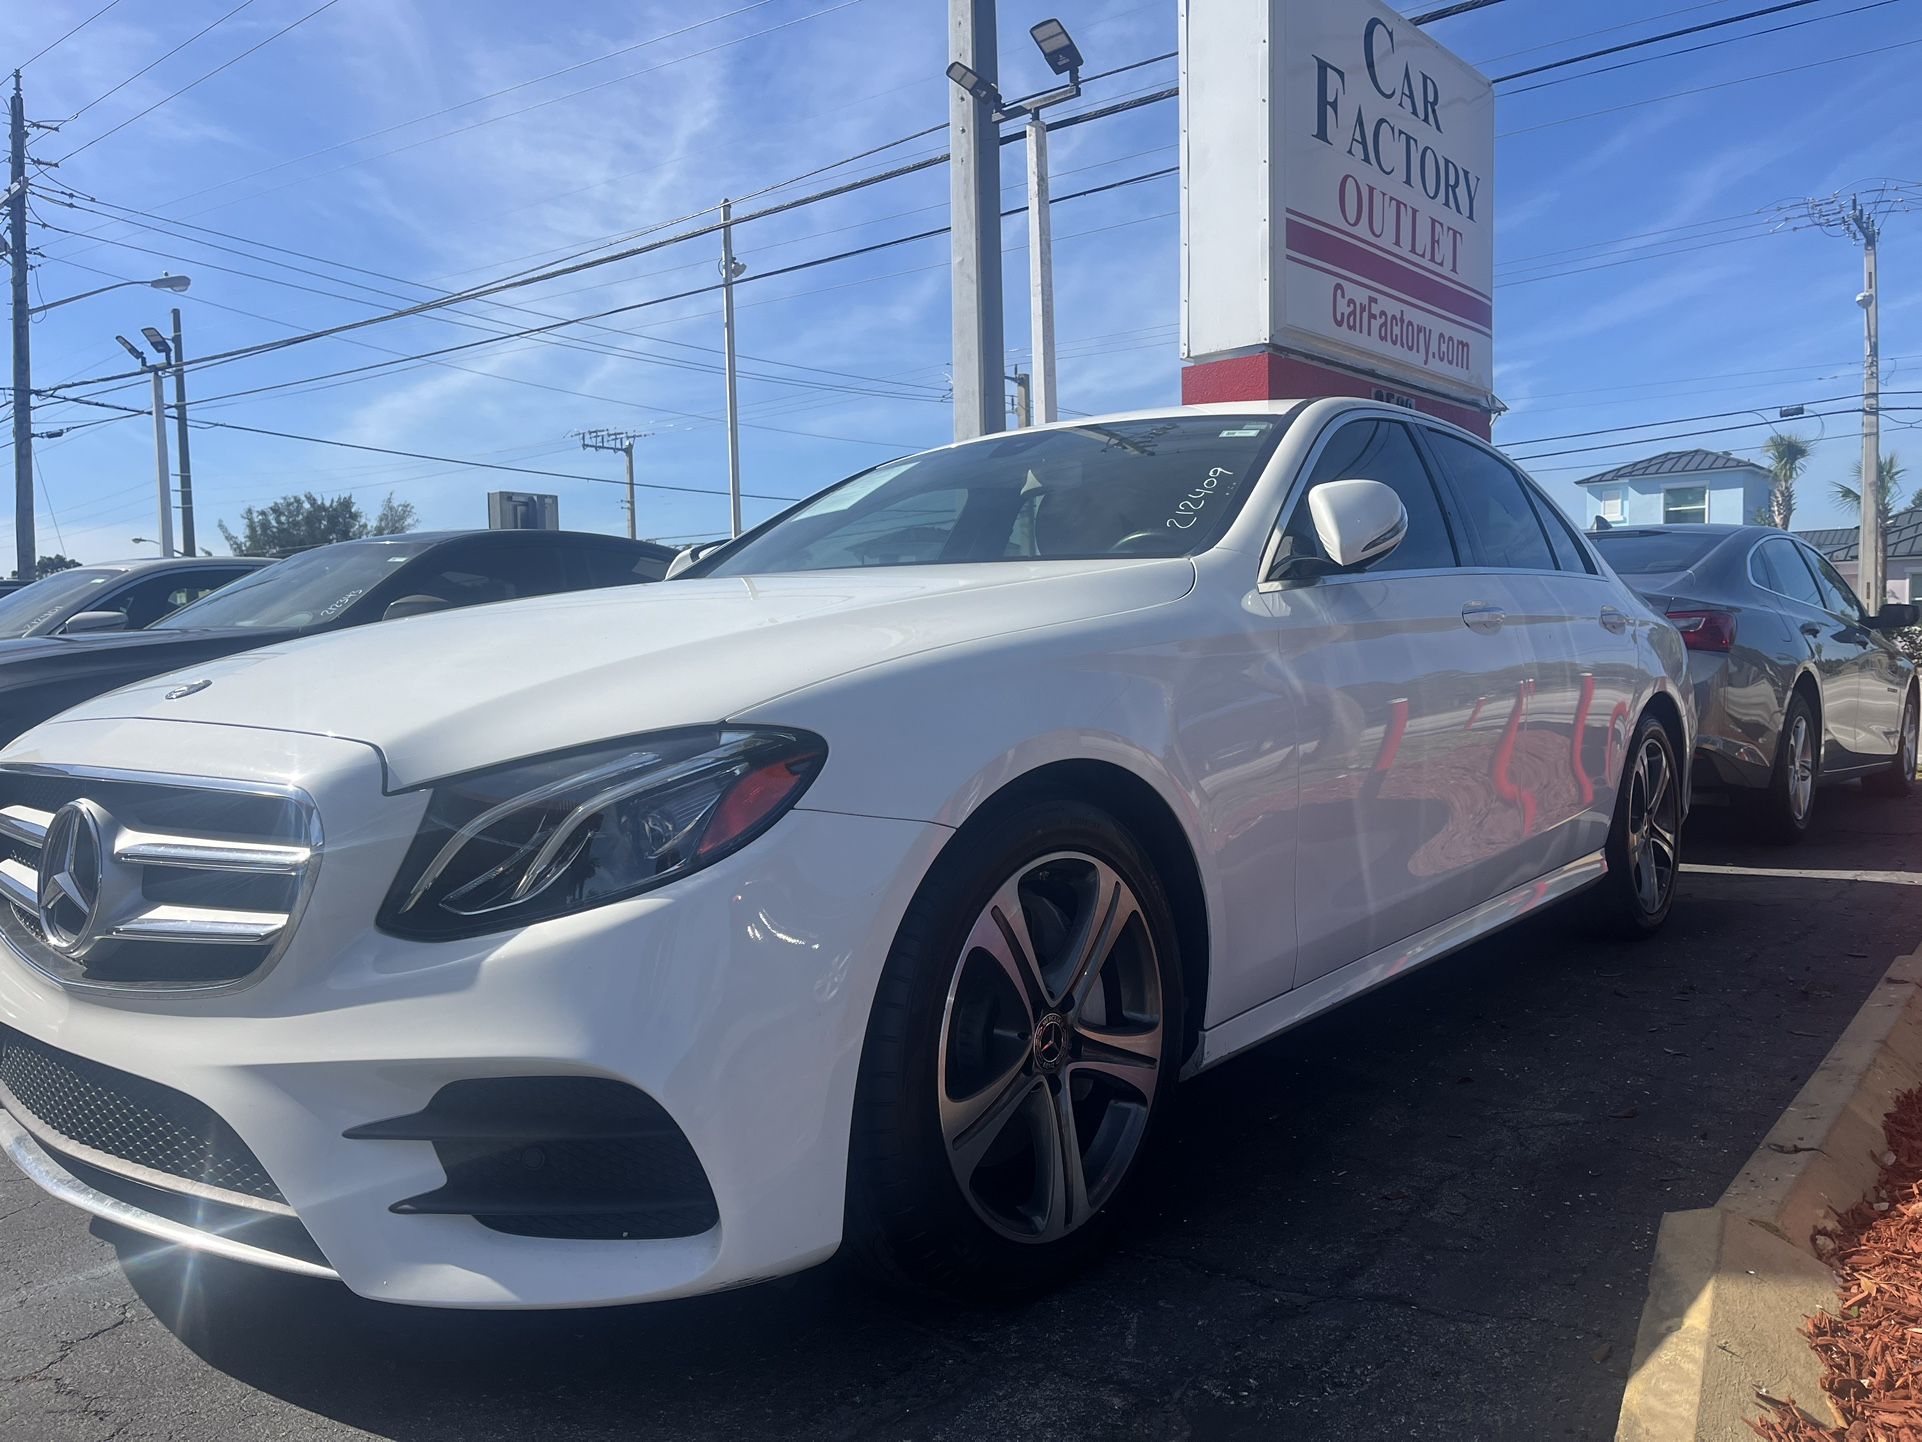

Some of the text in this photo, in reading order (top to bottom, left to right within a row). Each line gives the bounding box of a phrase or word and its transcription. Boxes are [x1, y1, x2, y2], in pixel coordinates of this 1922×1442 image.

[1363, 16, 1444, 135] CAR
[1311, 54, 1481, 224] FACTORY
[1338, 173, 1464, 276] OUTLET
[1332, 282, 1471, 371] CarFactory.com
[1166, 466, 1234, 529] 212409
